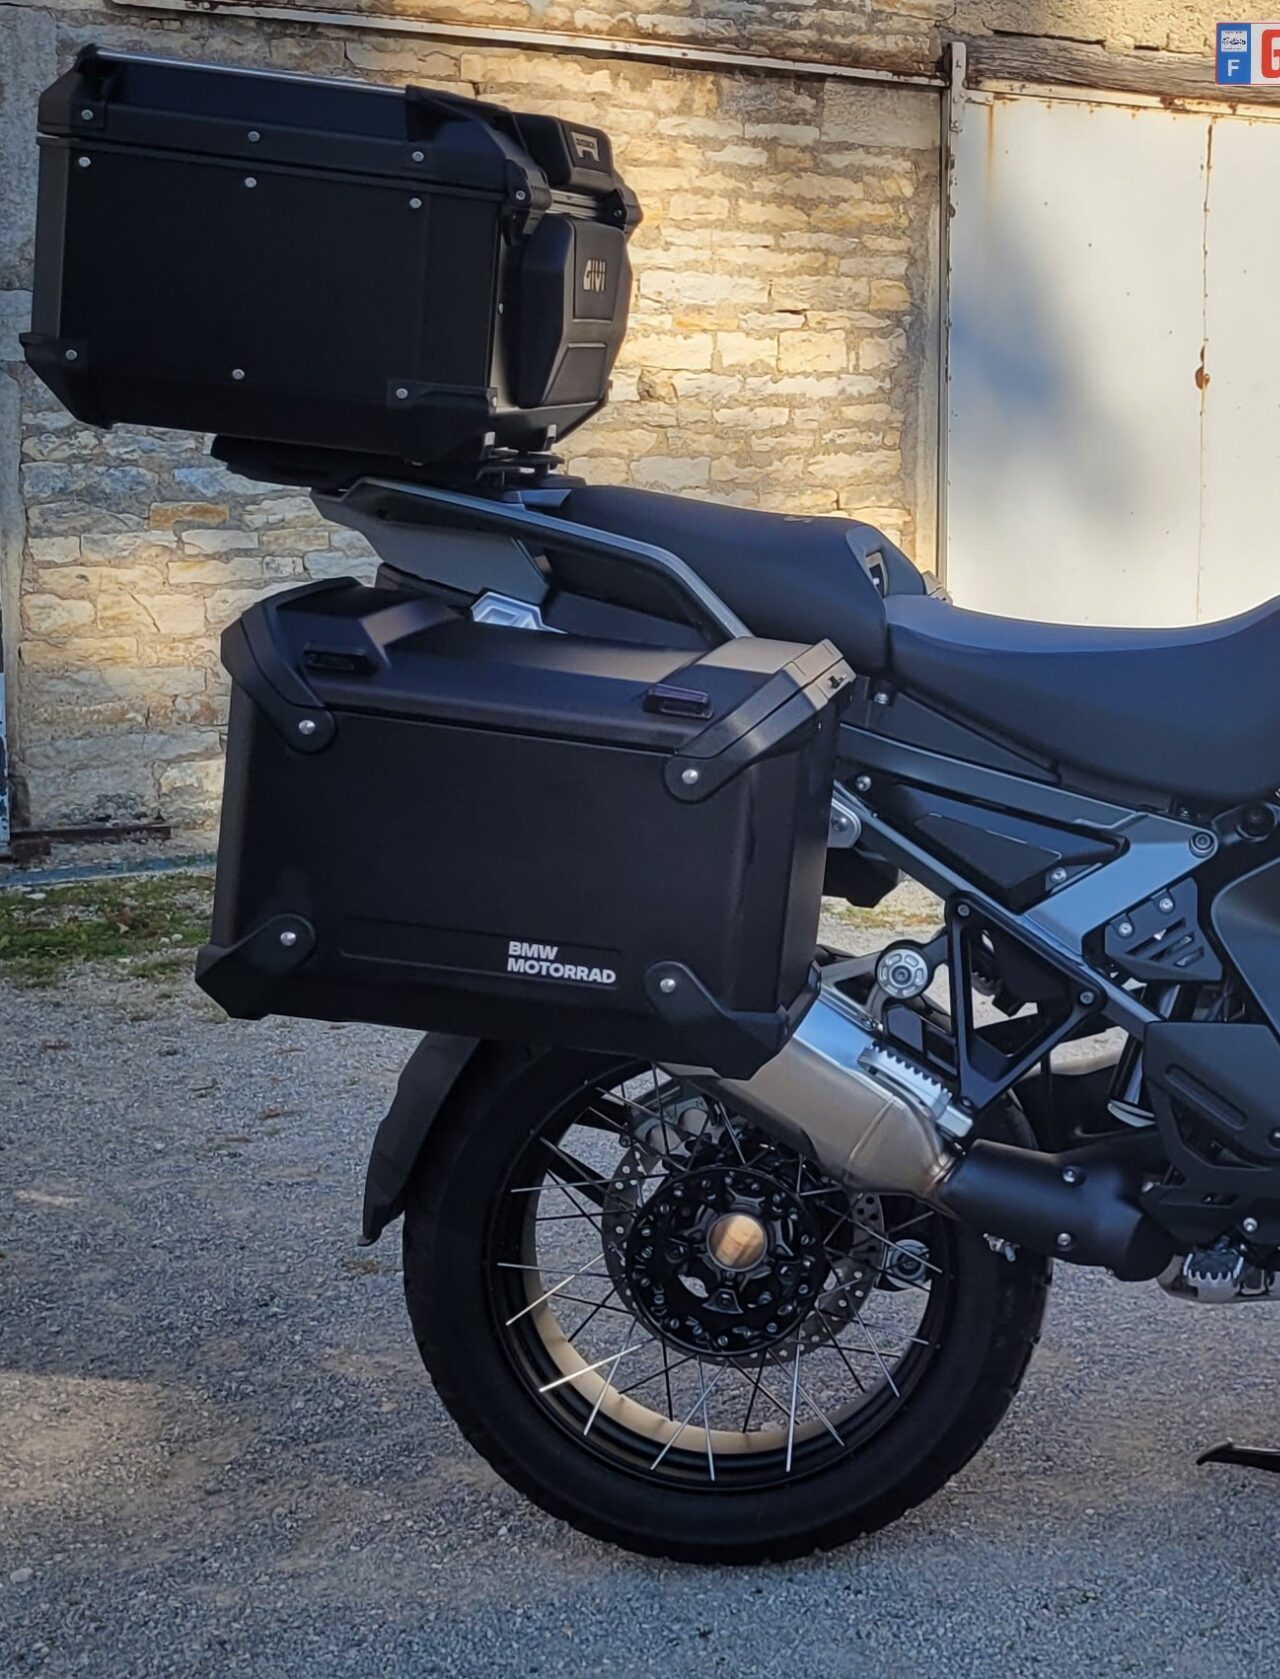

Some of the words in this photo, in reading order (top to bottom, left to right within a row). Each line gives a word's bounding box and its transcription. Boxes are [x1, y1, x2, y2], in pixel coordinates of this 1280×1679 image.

[1227, 58, 1240, 77] F
[508, 941, 559, 960] BMW
[507, 957, 617, 984] MOTORRAD
